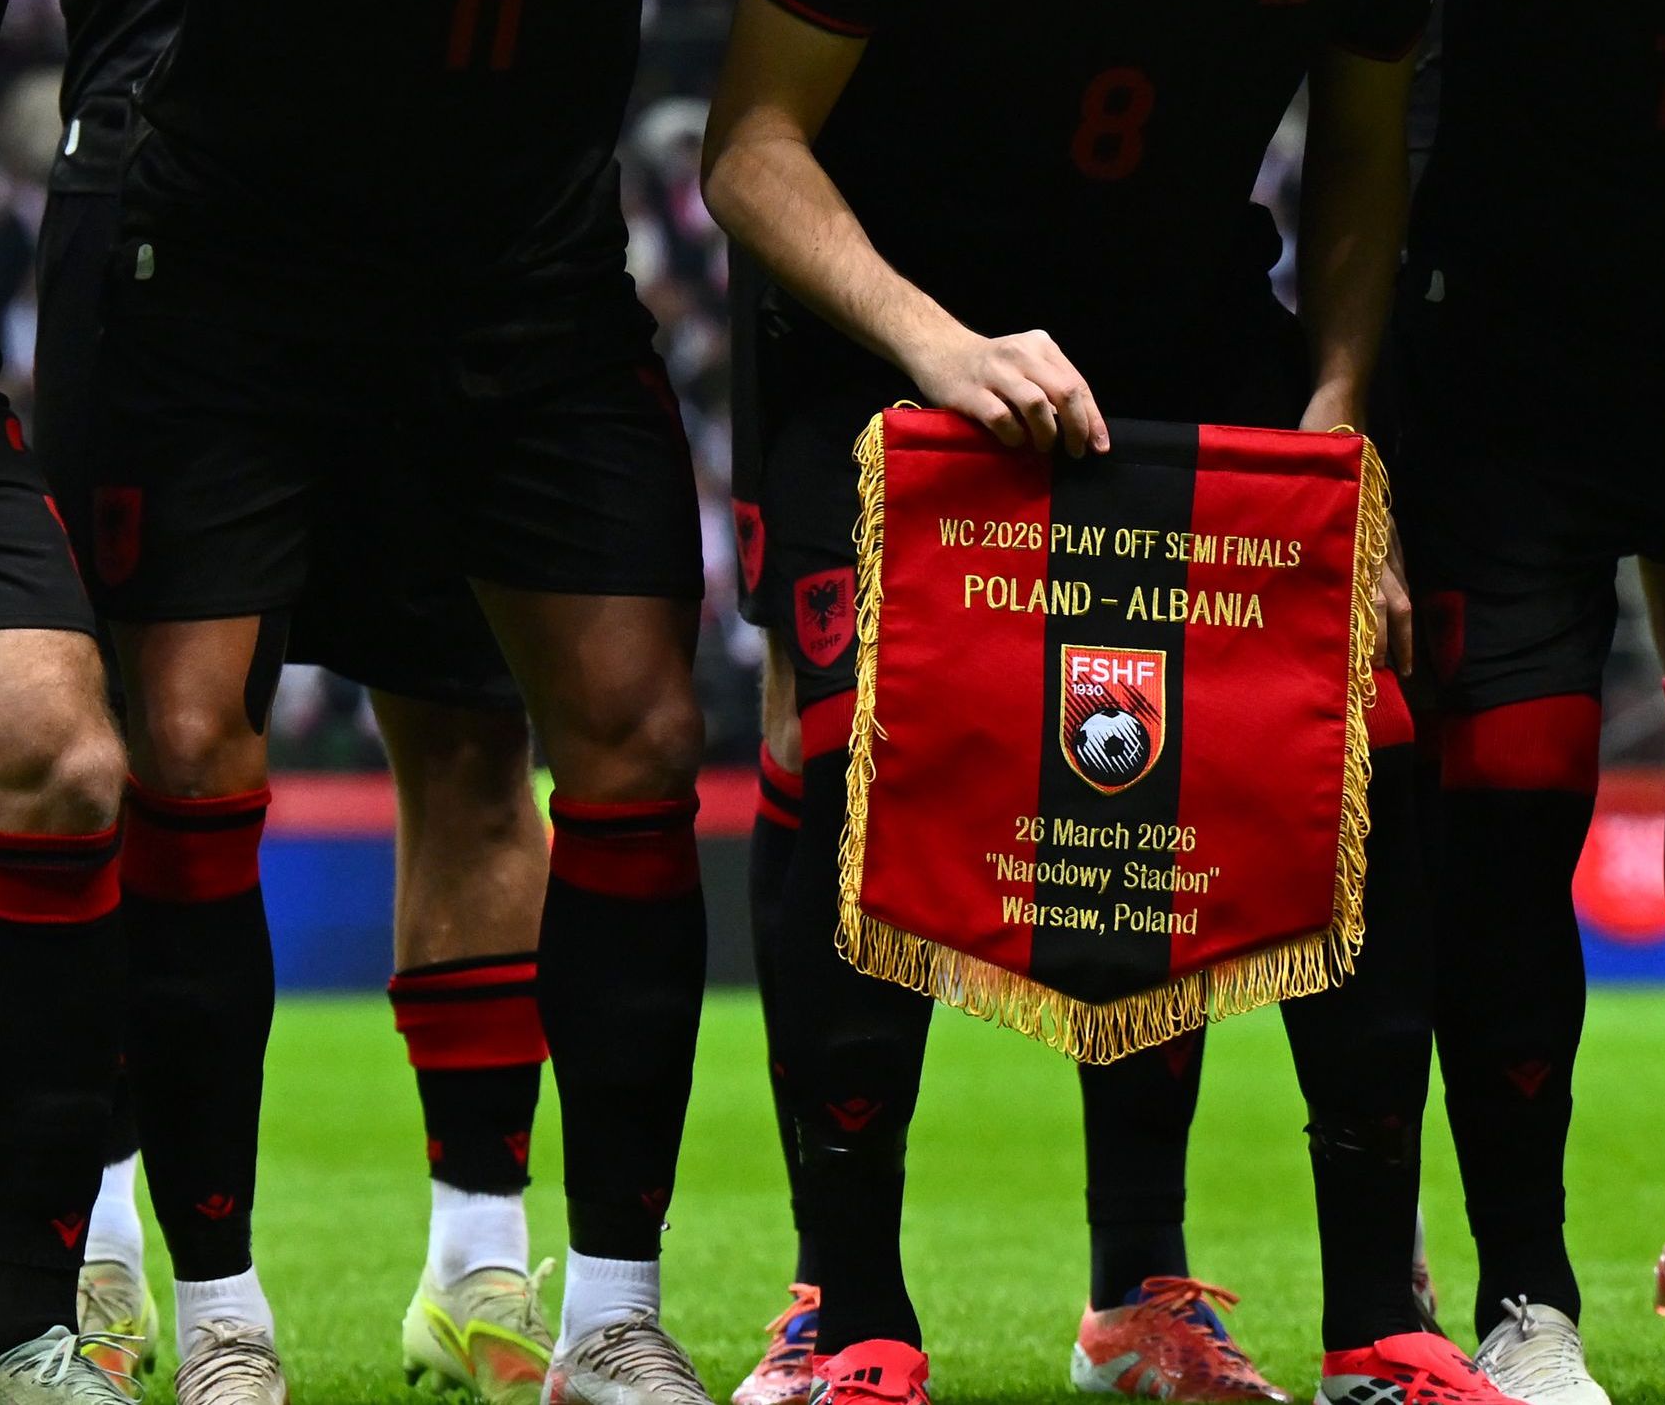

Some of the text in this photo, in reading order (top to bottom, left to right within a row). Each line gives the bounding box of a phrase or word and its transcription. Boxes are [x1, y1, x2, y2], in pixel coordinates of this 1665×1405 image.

[1070, 65, 1156, 183] 8
[939, 518, 1302, 568] WC 2026 PLAY OFF SEMI FINALS
[964, 574, 1091, 616] POLAND
[1125, 585, 1264, 629] ALBANIA
[1071, 656, 1155, 686] FSHF
[1071, 683, 1104, 697] 1930
[1015, 816, 1197, 853] 26 March 2026
[985, 852, 1220, 894] "Narodowy Stadion"
[1002, 895, 1198, 936] Warsaw, Poland
